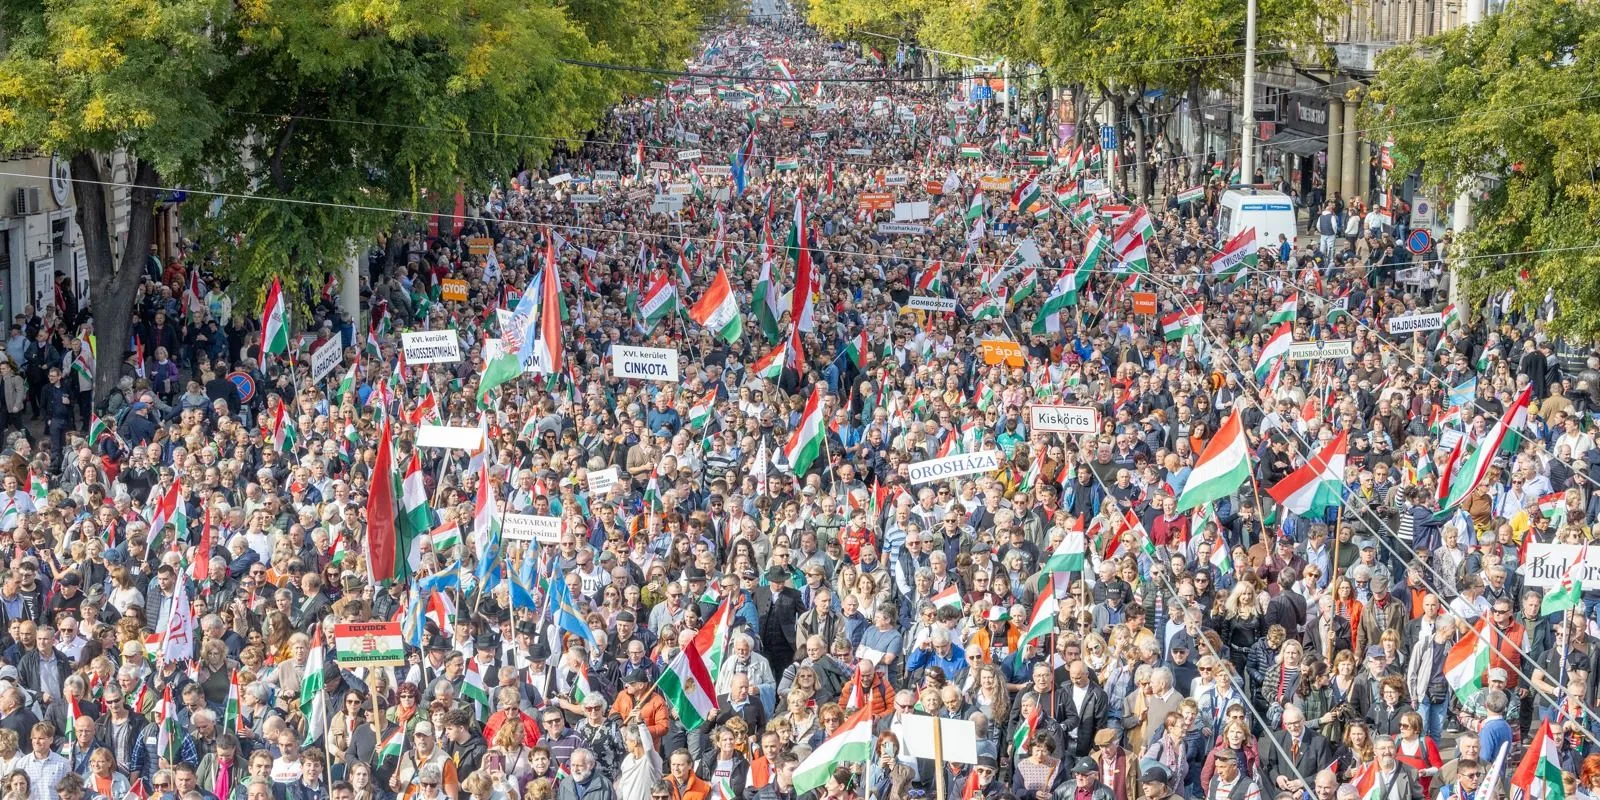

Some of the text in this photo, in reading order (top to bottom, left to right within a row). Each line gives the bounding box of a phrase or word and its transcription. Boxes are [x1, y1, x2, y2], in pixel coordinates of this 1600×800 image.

[882, 224, 921, 233] Taktaharkány
[911, 299, 953, 308] GOMBOSSZEG
[1391, 316, 1441, 331] HAJDÚSÁMSON
[425, 334, 448, 342] kerület
[406, 343, 457, 359] RÁKOSSZENTMIHÁLY
[623, 350, 667, 359] XVI. kerület
[984, 345, 1022, 357] Pápa
[624, 362, 668, 376] CINKOTA
[1038, 413, 1089, 426] Kiskőrös
[910, 455, 996, 480] OROSHÁZA
[513, 527, 557, 538] Fortissima
